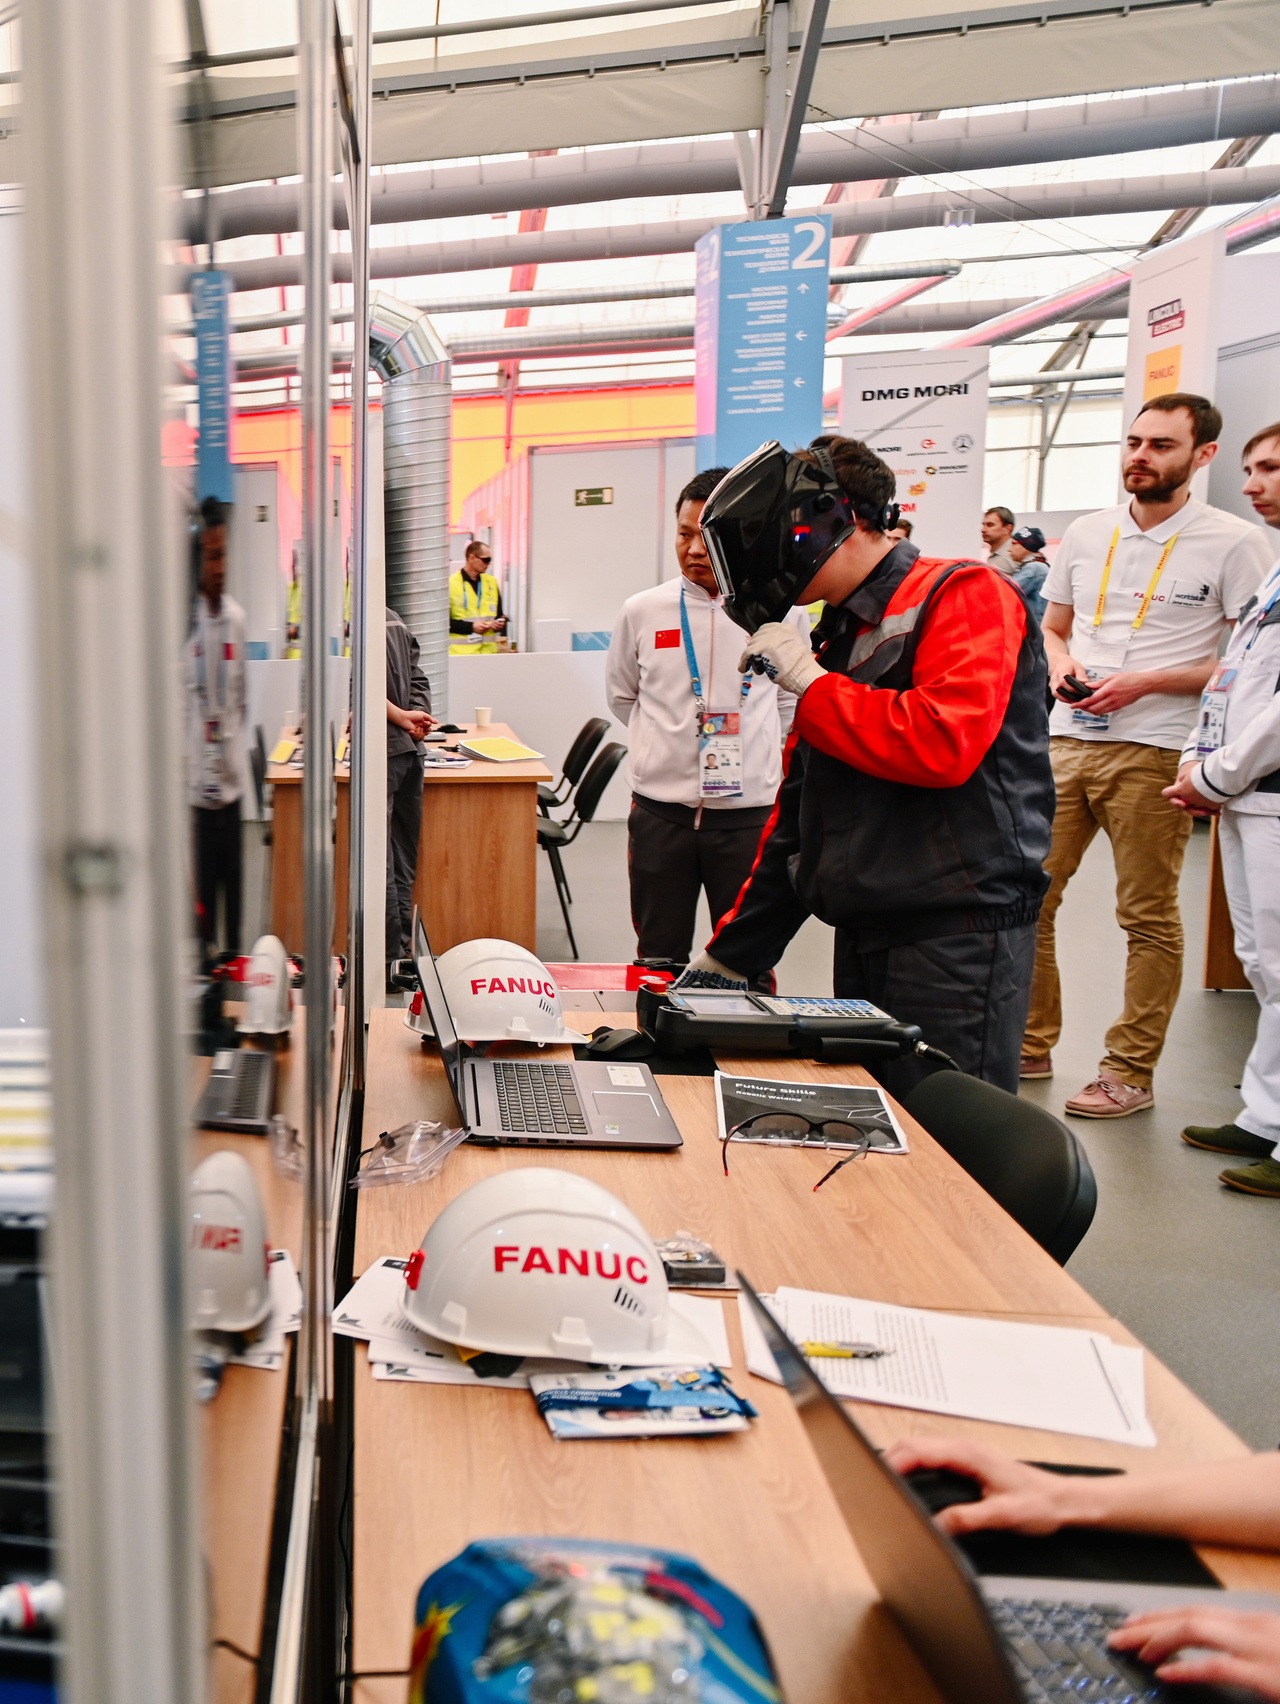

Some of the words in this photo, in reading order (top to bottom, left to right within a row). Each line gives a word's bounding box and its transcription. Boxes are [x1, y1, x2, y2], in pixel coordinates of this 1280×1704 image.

[792, 222, 827, 270] 2
[1149, 365, 1176, 381] FANUC
[861, 387, 910, 402] DMG
[914, 383, 969, 398] MORI
[1106, 546, 1114, 567] FANUC
[1157, 548, 1170, 570] FANUC
[1096, 594, 1104, 615] FANUC
[1134, 592, 1166, 602] FAUC
[1137, 597, 1149, 618] FANUC
[471, 977, 555, 998] FANUC
[735, 1083, 777, 1092] Future
[779, 1088, 817, 1096] Skills
[736, 1090, 766, 1098] Robotic
[494, 1246, 648, 1284] FANUC
